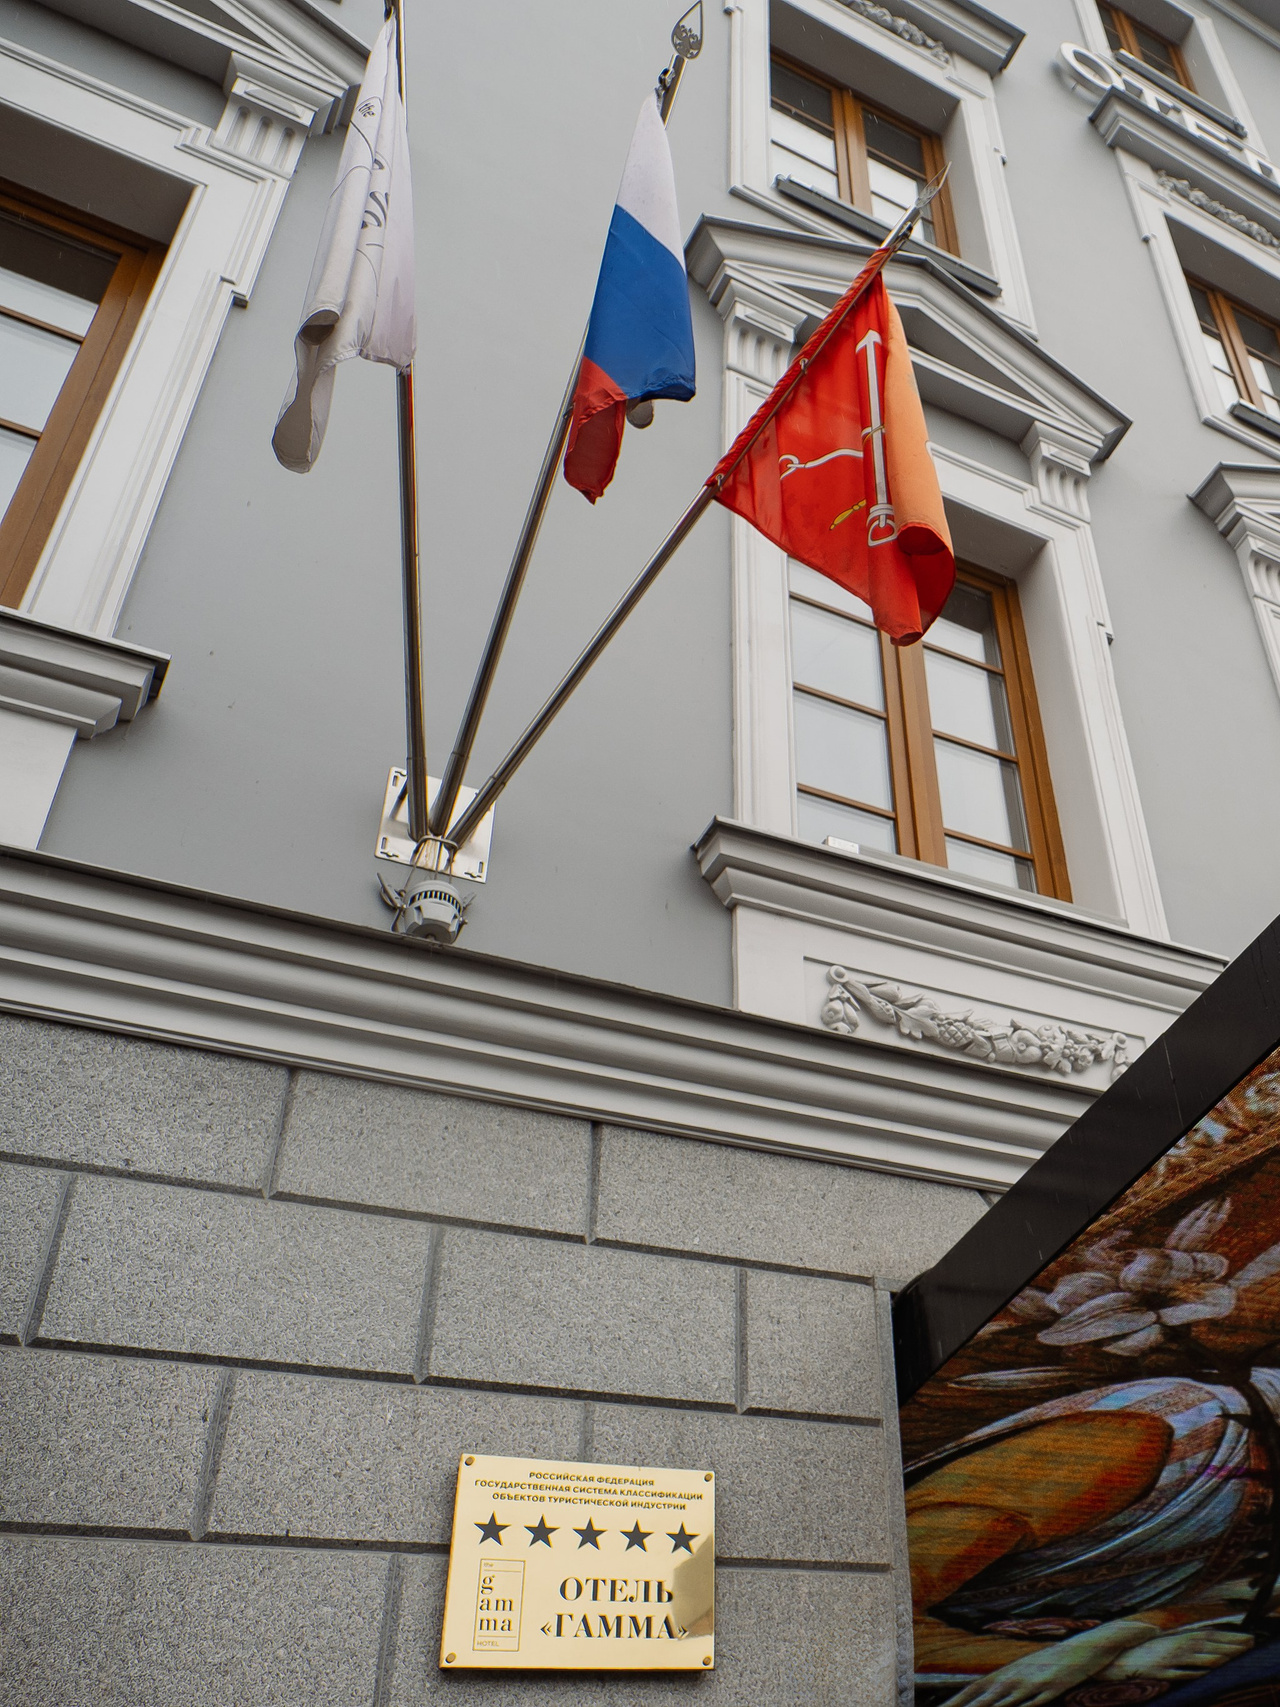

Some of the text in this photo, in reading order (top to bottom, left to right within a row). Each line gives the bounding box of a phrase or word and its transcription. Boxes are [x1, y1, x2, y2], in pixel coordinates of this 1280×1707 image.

[474, 1479, 704, 1501] ГОСУДАРСТВЕННАЯ СИСТЕМА КЛАССИФИКАЦИИ
[529, 1471, 655, 1487] РОССИЙСКАЯ ФЕДЕРАЦИЯ
[492, 1492, 687, 1511] ОБЪЕКТОВ ТУРИСТИЧЕСКОЙ ИНДУСТРИИ
[559, 1576, 674, 1604] ОТЕЛЬ
[540, 1612, 690, 1641] «ГАММА»
